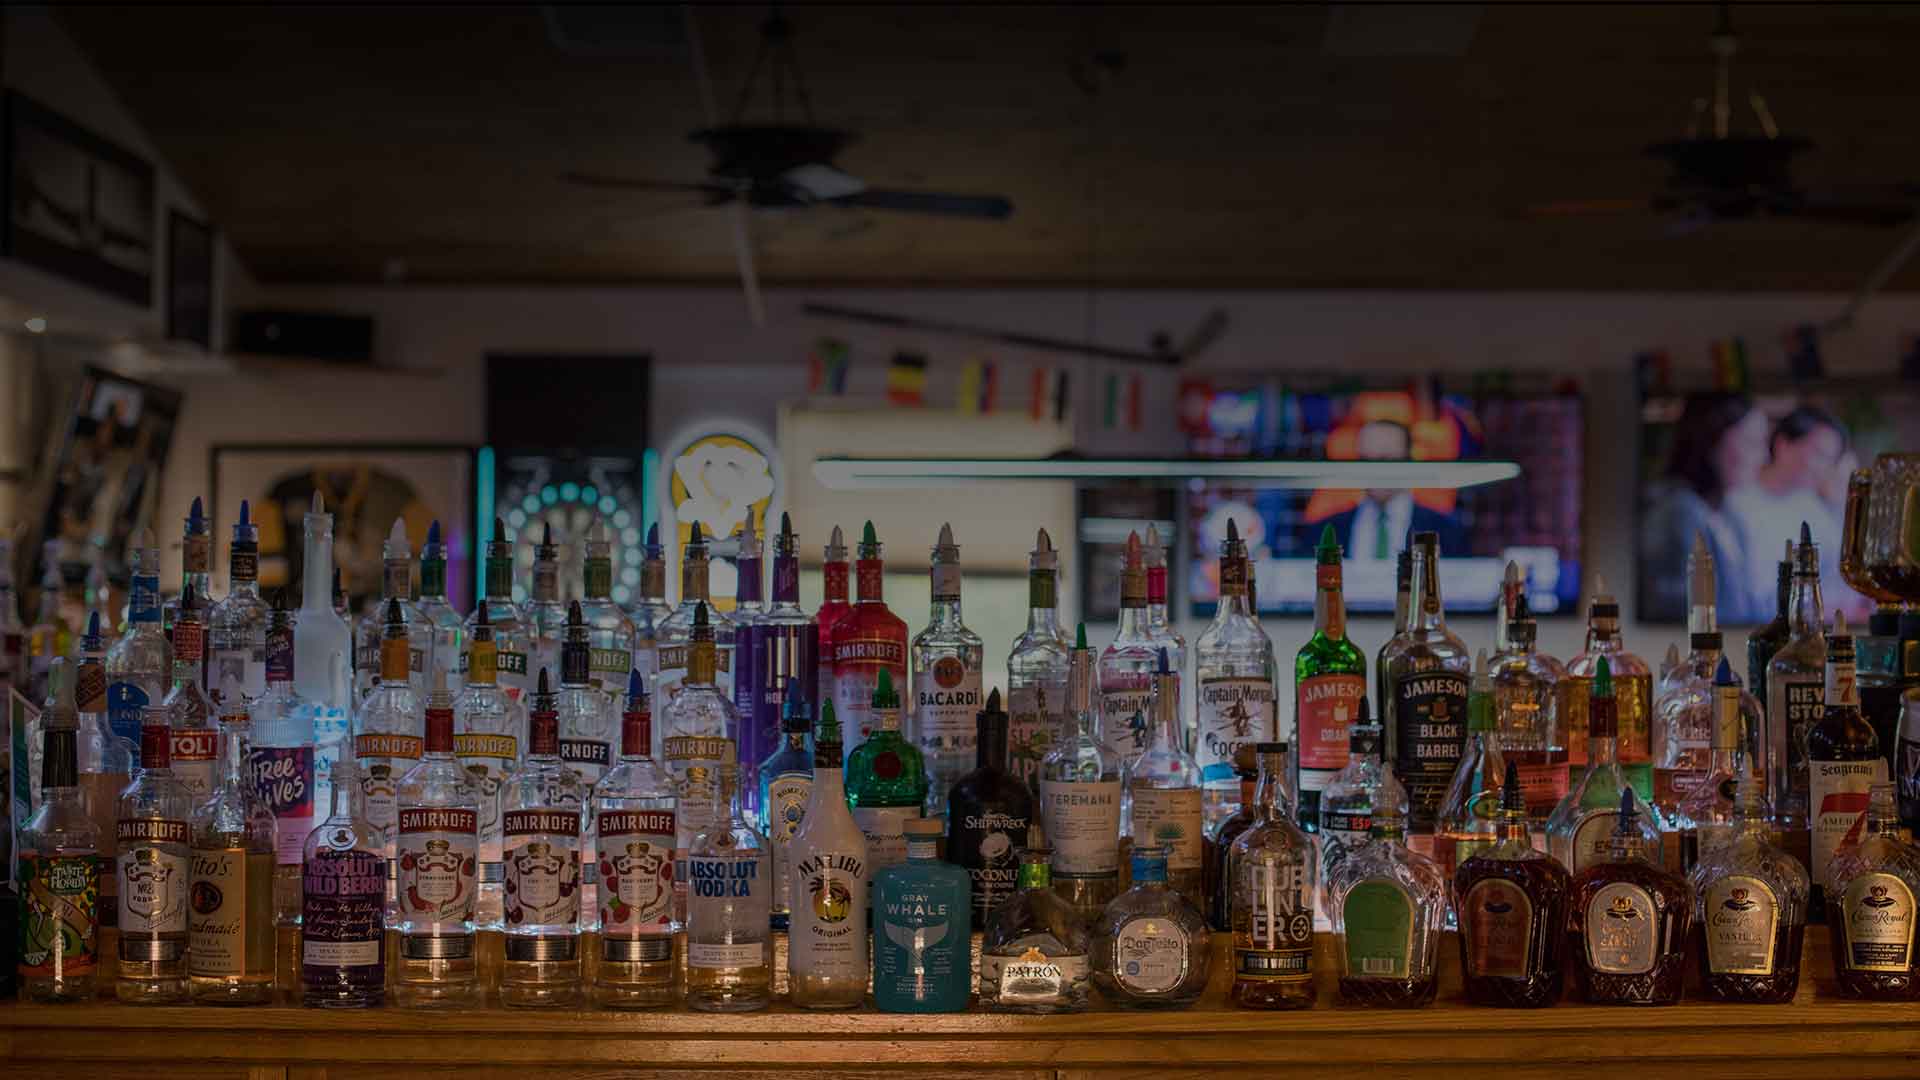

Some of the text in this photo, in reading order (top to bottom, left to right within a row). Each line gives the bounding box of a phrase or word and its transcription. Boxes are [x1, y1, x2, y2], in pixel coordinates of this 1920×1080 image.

[834, 643, 901, 660] SMIRNOFF
[1203, 686, 1239, 705] Captain
[1304, 682, 1366, 704] JAMESO
[1403, 680, 1466, 699] JAMESON
[1838, 677, 1853, 702] 7
[1790, 704, 1824, 720] STO
[1420, 723, 1458, 738] BLACK
[170, 736, 214, 755] TOLI
[561, 742, 608, 759] RNOFF
[1416, 744, 1460, 759] BARREL
[402, 812, 473, 829] SMIRNOFF
[504, 814, 576, 832] SMIRNOFF
[601, 814, 672, 832] SMIRNOFF
[964, 814, 1027, 830] SHIPWRECK
[118, 821, 184, 839] SMIRNOFF
[690, 861, 757, 879] ABSOLUT
[798, 854, 865, 880] MALIBU
[970, 869, 1018, 881] OCONU
[694, 880, 750, 897] VODKA
[901, 894, 929, 903] GRAY
[886, 904, 948, 916] WHALE
[812, 926, 853, 938] ORIGINAL
[1007, 964, 1061, 978] PATRÓN
